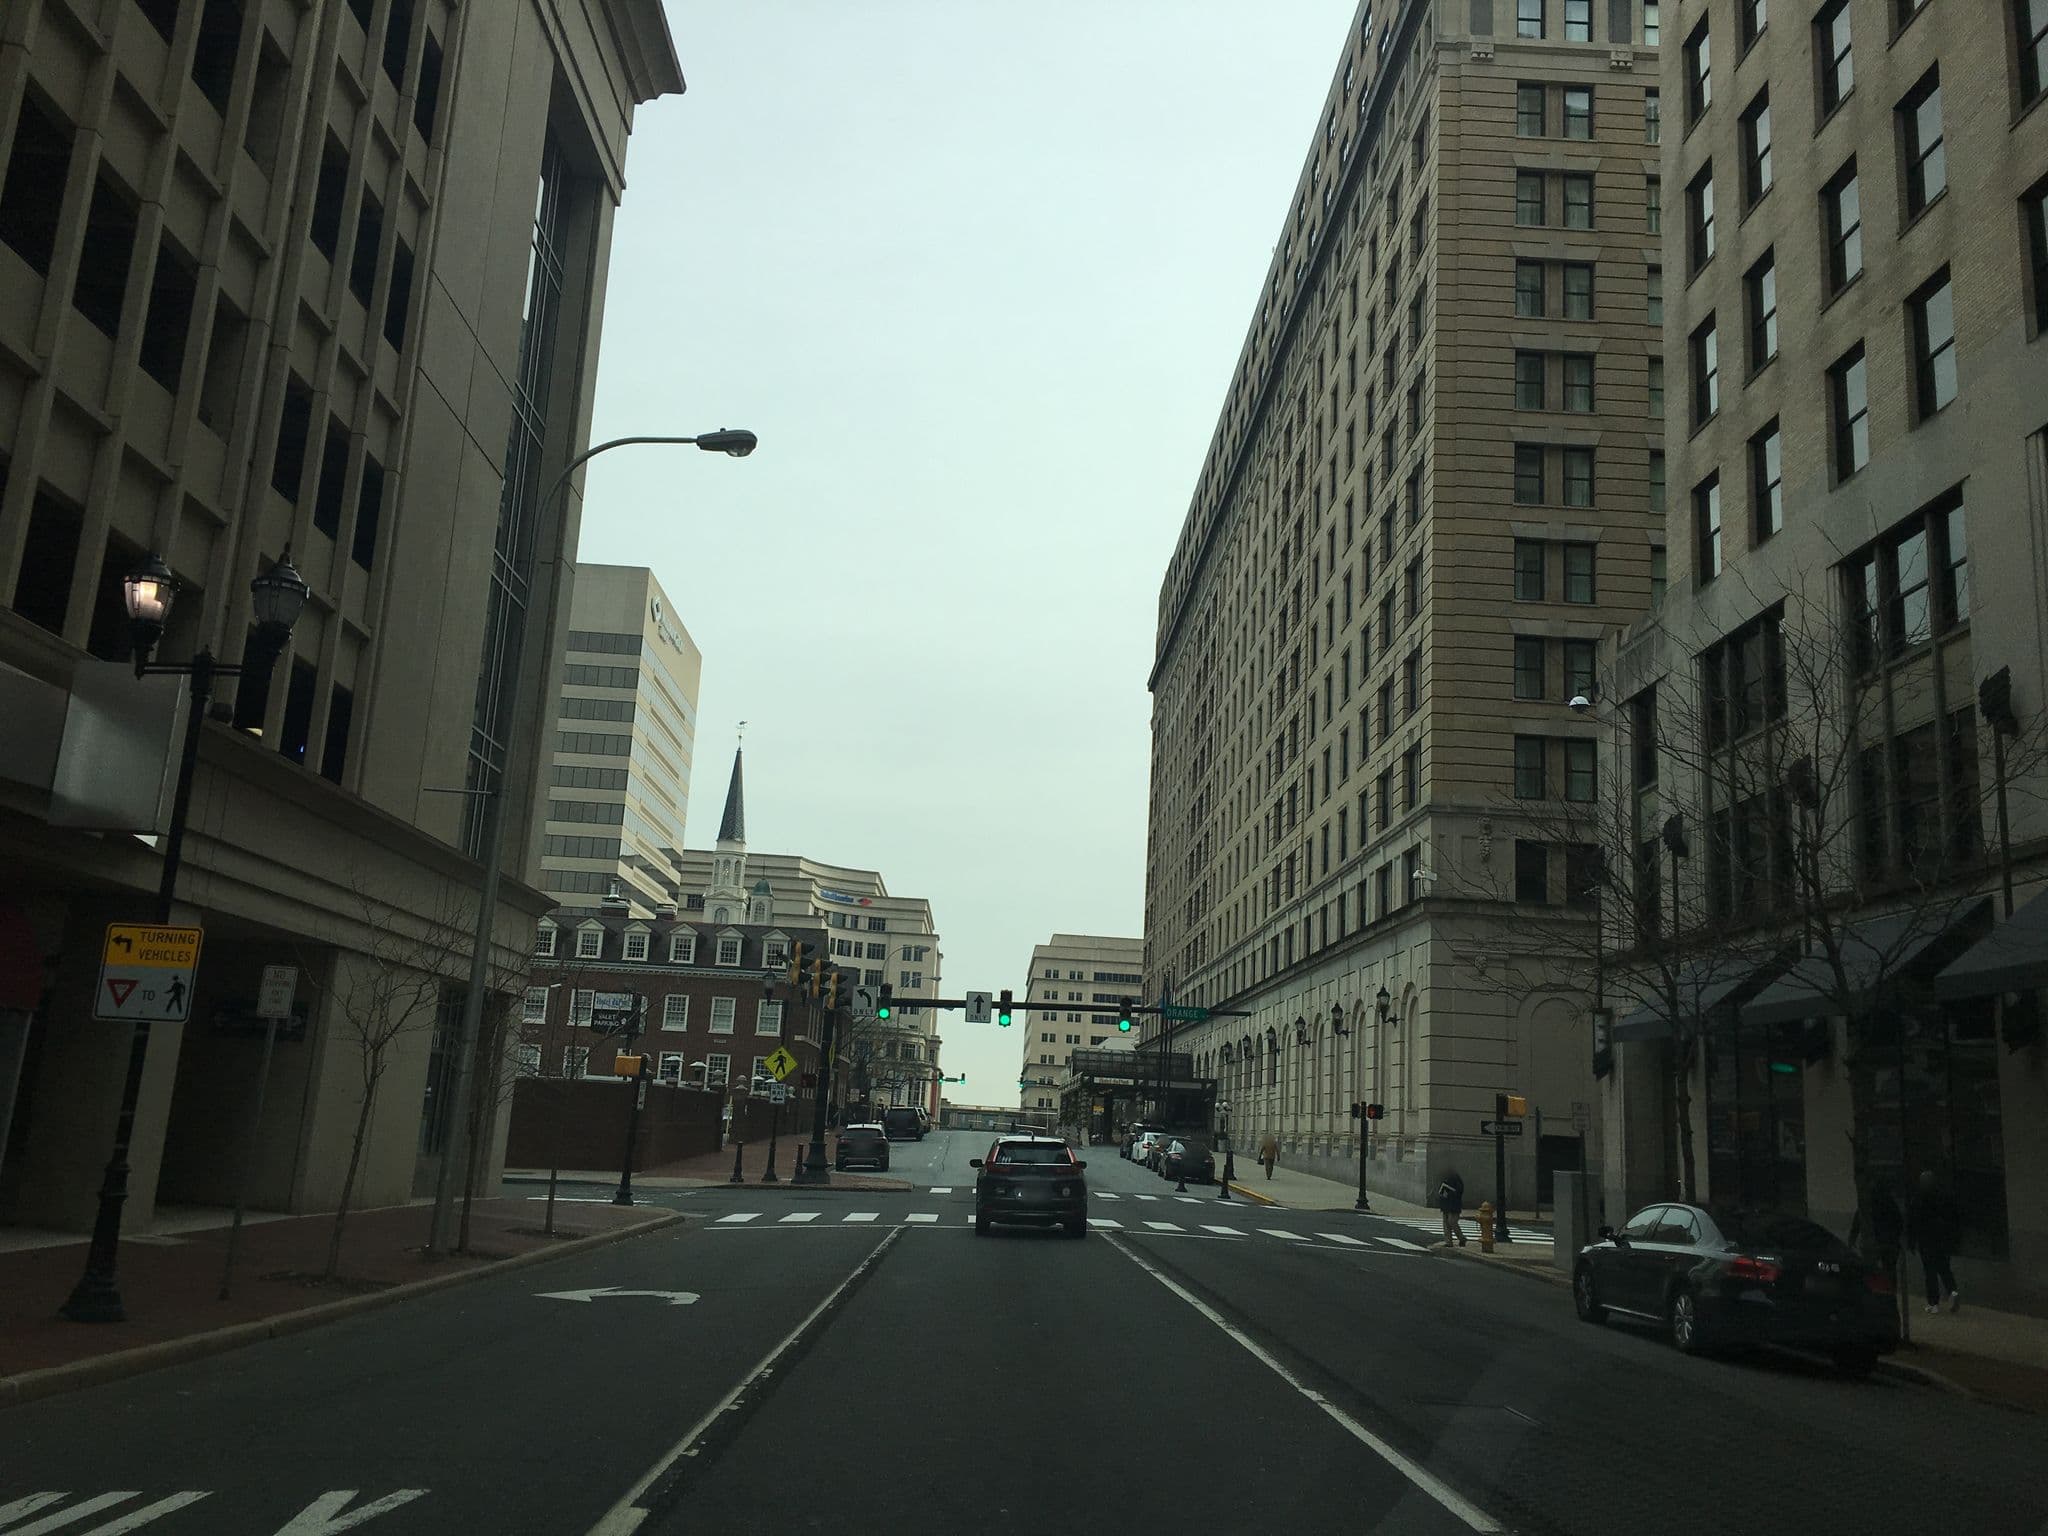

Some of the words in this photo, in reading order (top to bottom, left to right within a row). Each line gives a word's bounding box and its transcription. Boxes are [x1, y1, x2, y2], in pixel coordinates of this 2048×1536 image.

[140, 931, 195, 945] TURNING
[138, 949, 191, 962] VEHICLES
[142, 990, 156, 1001] TO
[1166, 1008, 1198, 1018] ORANGE
